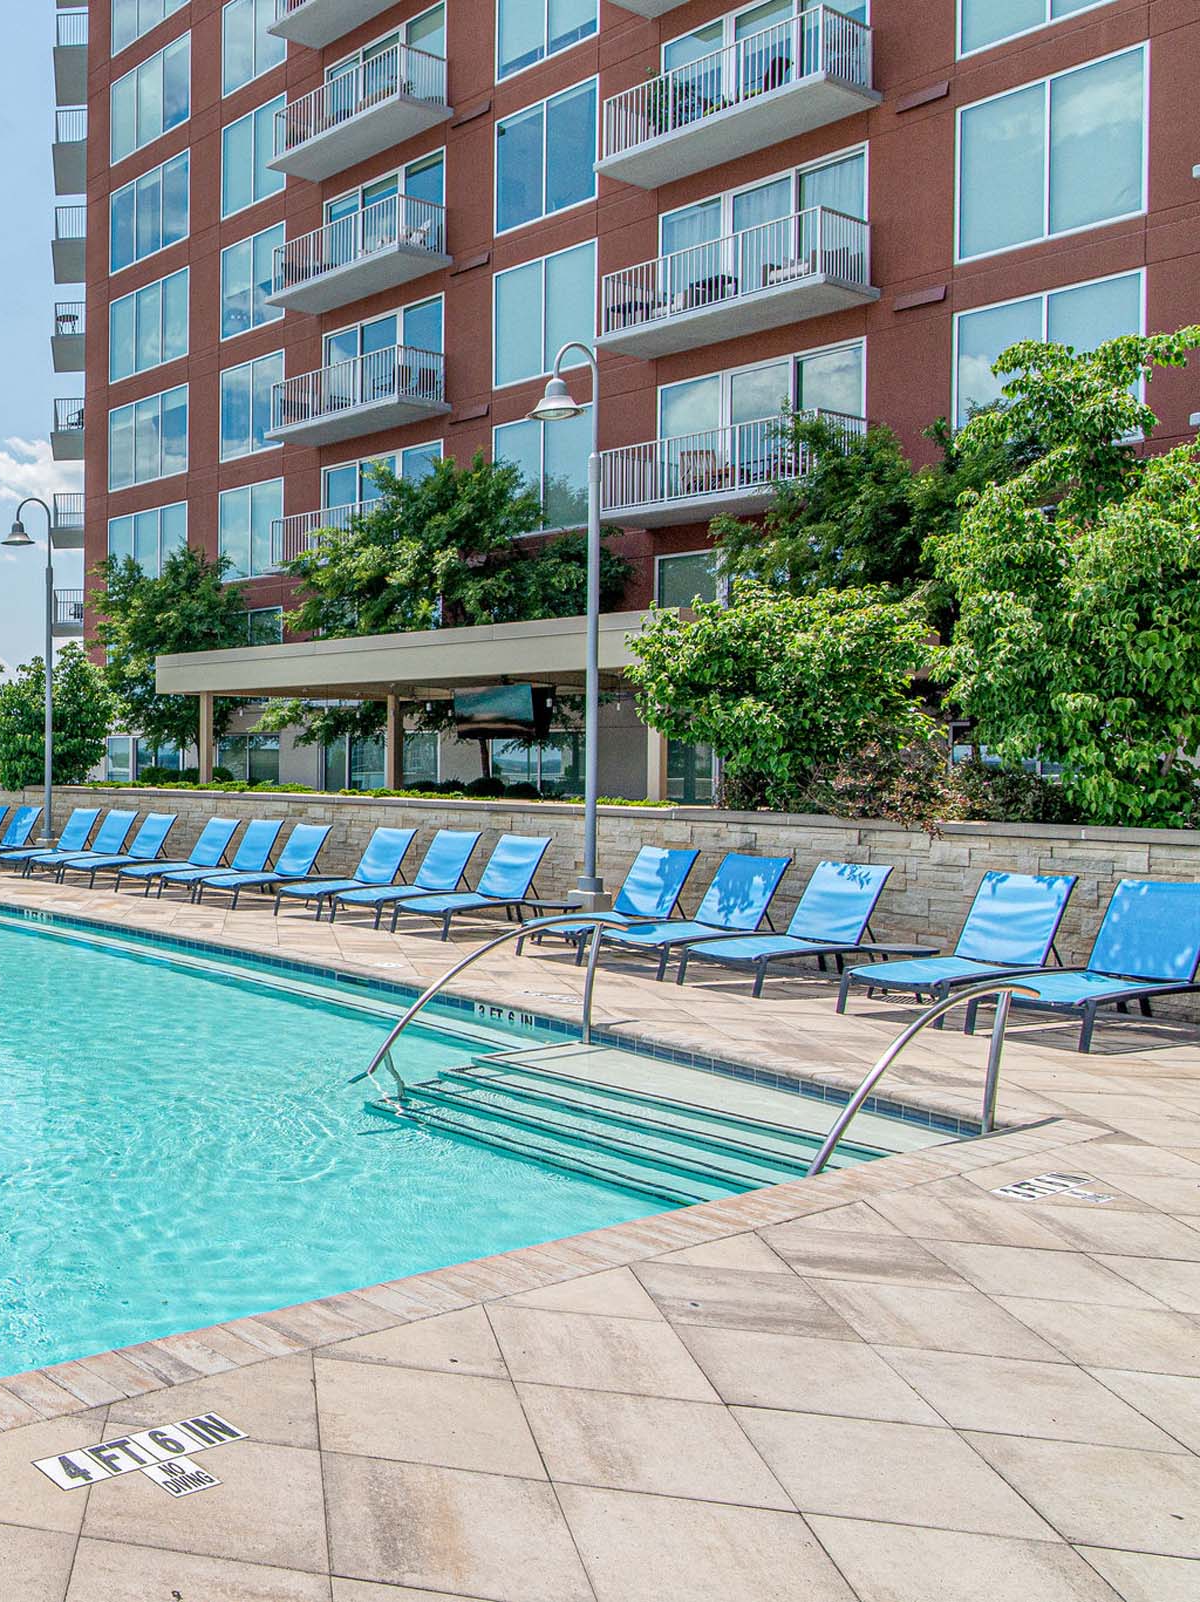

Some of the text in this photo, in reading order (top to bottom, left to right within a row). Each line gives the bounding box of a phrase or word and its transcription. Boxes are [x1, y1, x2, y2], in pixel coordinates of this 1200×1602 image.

[521, 1013, 533, 1026] IN
[1012, 1182, 1056, 1195] FT
[57, 1415, 241, 1481] 4 FT 6 IN
[157, 1461, 188, 1478] NO
[161, 1470, 215, 1495] DIVING
